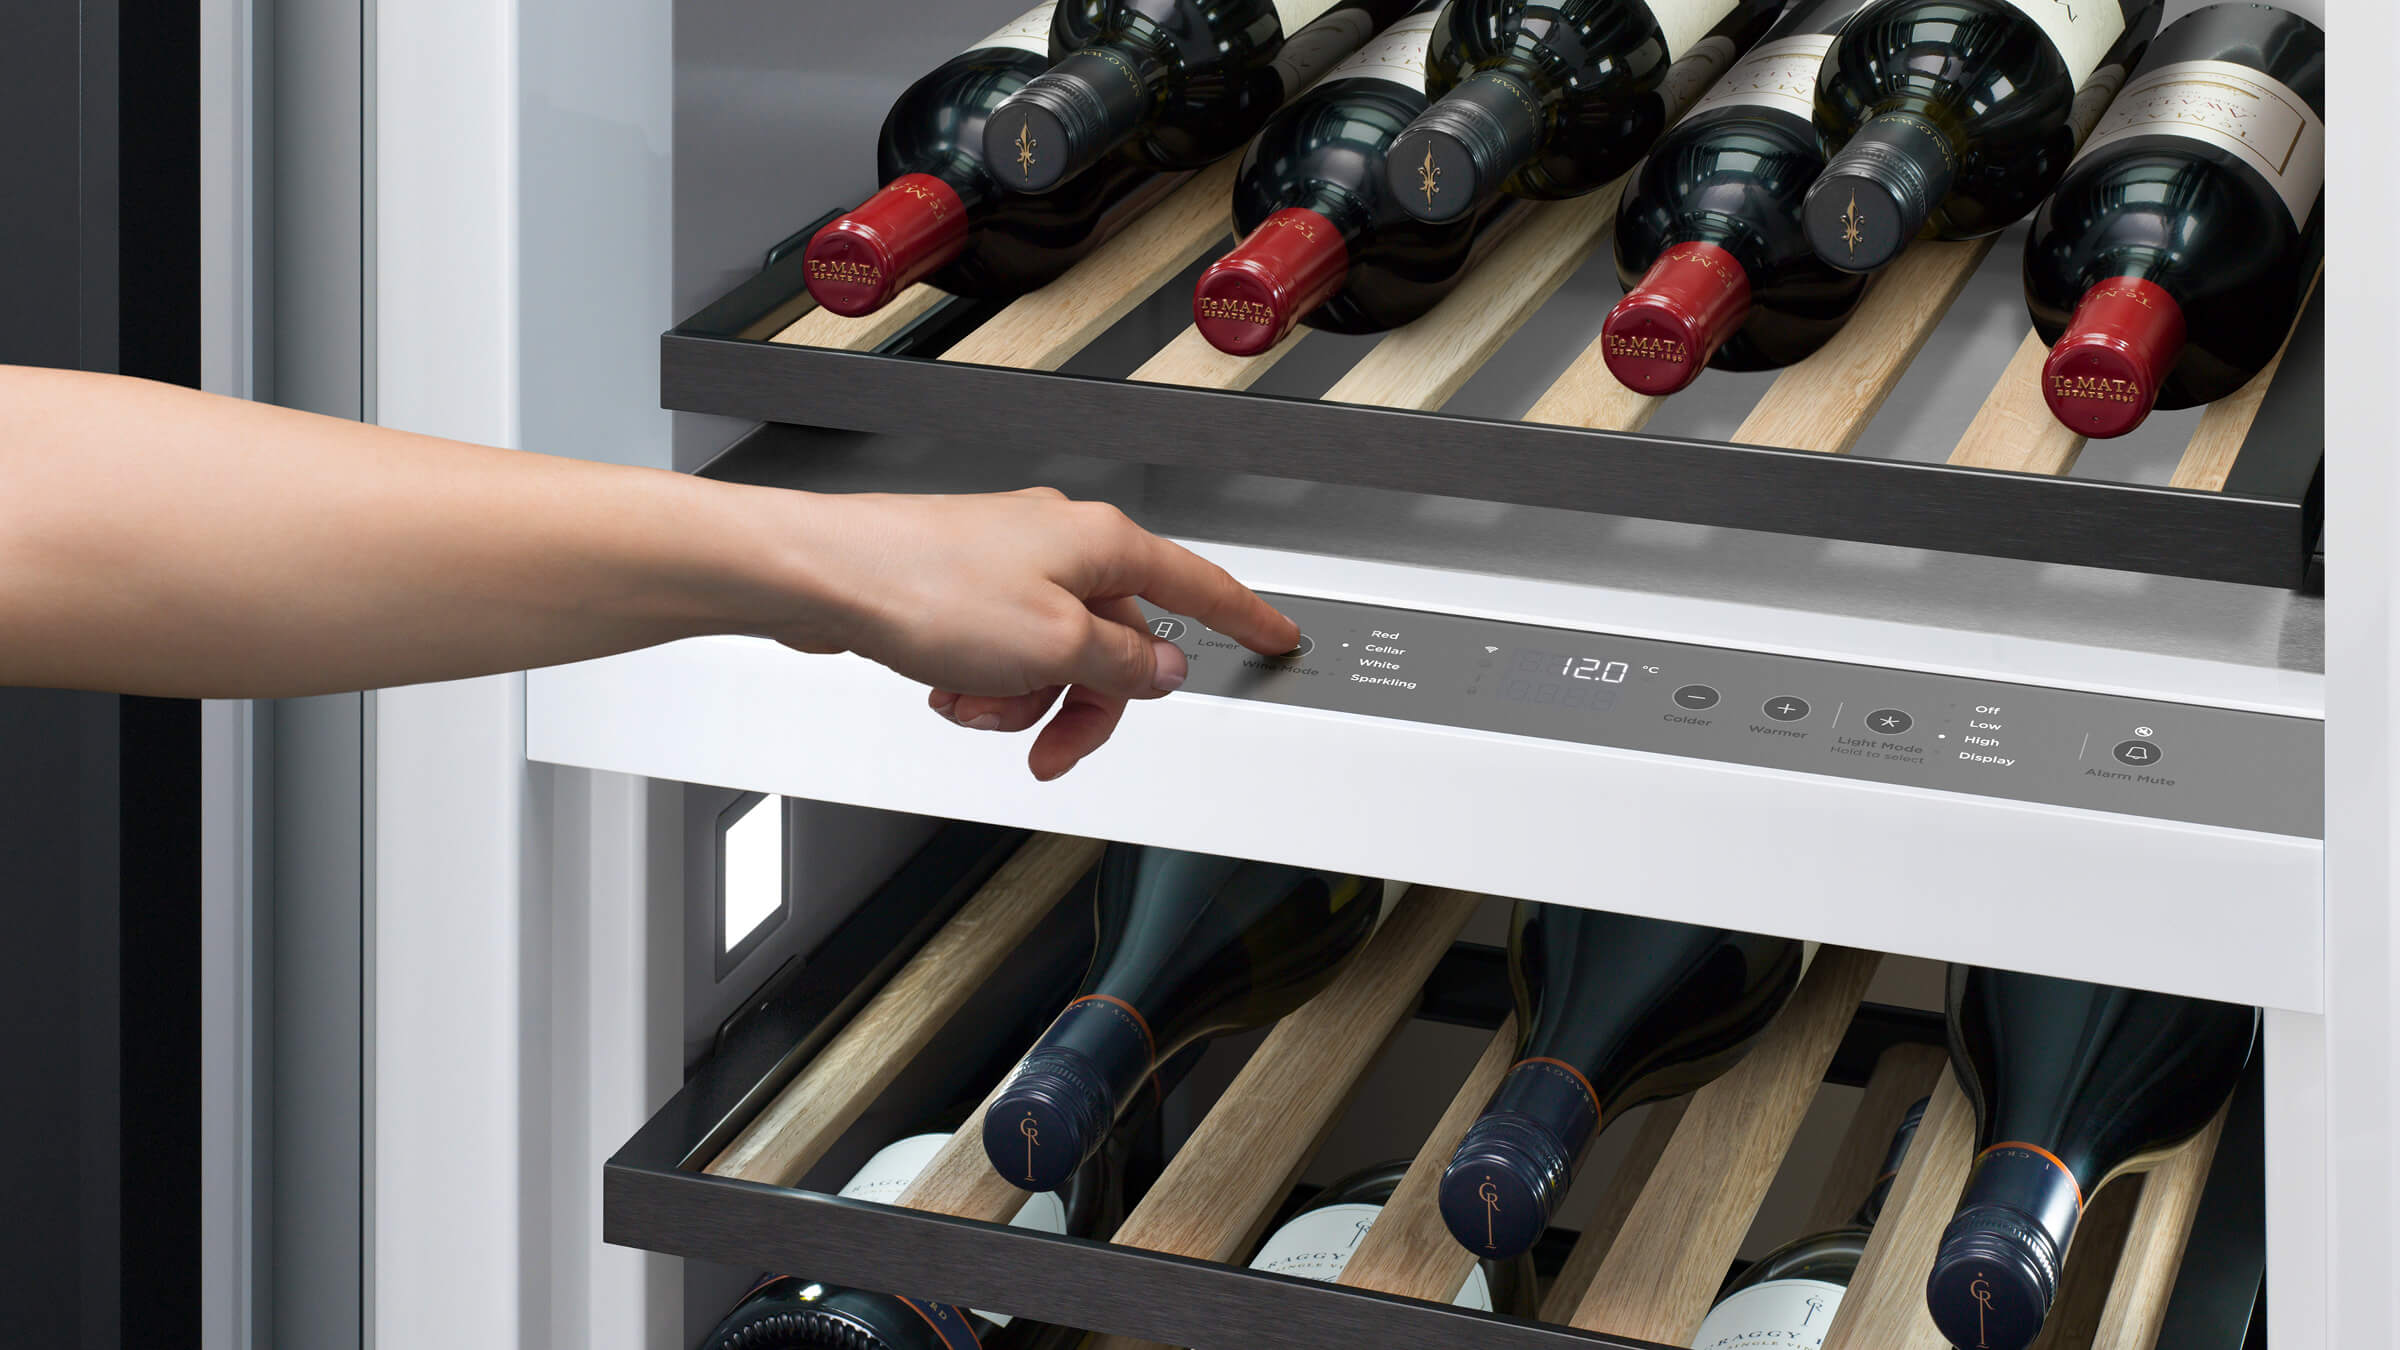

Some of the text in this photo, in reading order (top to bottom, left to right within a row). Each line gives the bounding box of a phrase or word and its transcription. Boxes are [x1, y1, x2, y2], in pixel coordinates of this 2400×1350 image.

[807, 259, 882, 278] Te MATA
[1199, 297, 1275, 318] Te MATA
[1203, 310, 1246, 321] ESTATE
[1605, 334, 1687, 355] Te MATA
[1611, 348, 1655, 359] ESTATE
[2049, 375, 2140, 395] Te MATA
[2056, 388, 2104, 400] ESTATE
[1371, 630, 1400, 640] Red
[1198, 639, 1241, 651] Lower
[1365, 644, 1407, 655] Cellar
[1242, 660, 1320, 676] Wine Mode
[1360, 658, 1400, 670] White
[1562, 657, 1629, 684] 12.0
[1350, 673, 1417, 690] Sparkling
[1975, 705, 2001, 716] Off
[1663, 713, 1713, 727] Colder
[1970, 719, 2002, 731] Low
[1749, 725, 1808, 739] Warmer
[1837, 736, 1924, 754] Light Mode
[1964, 735, 2000, 748] High
[1830, 746, 1925, 765] Hold to select
[1959, 752, 2016, 768] Display
[2085, 768, 2176, 786] Alarm Mute
